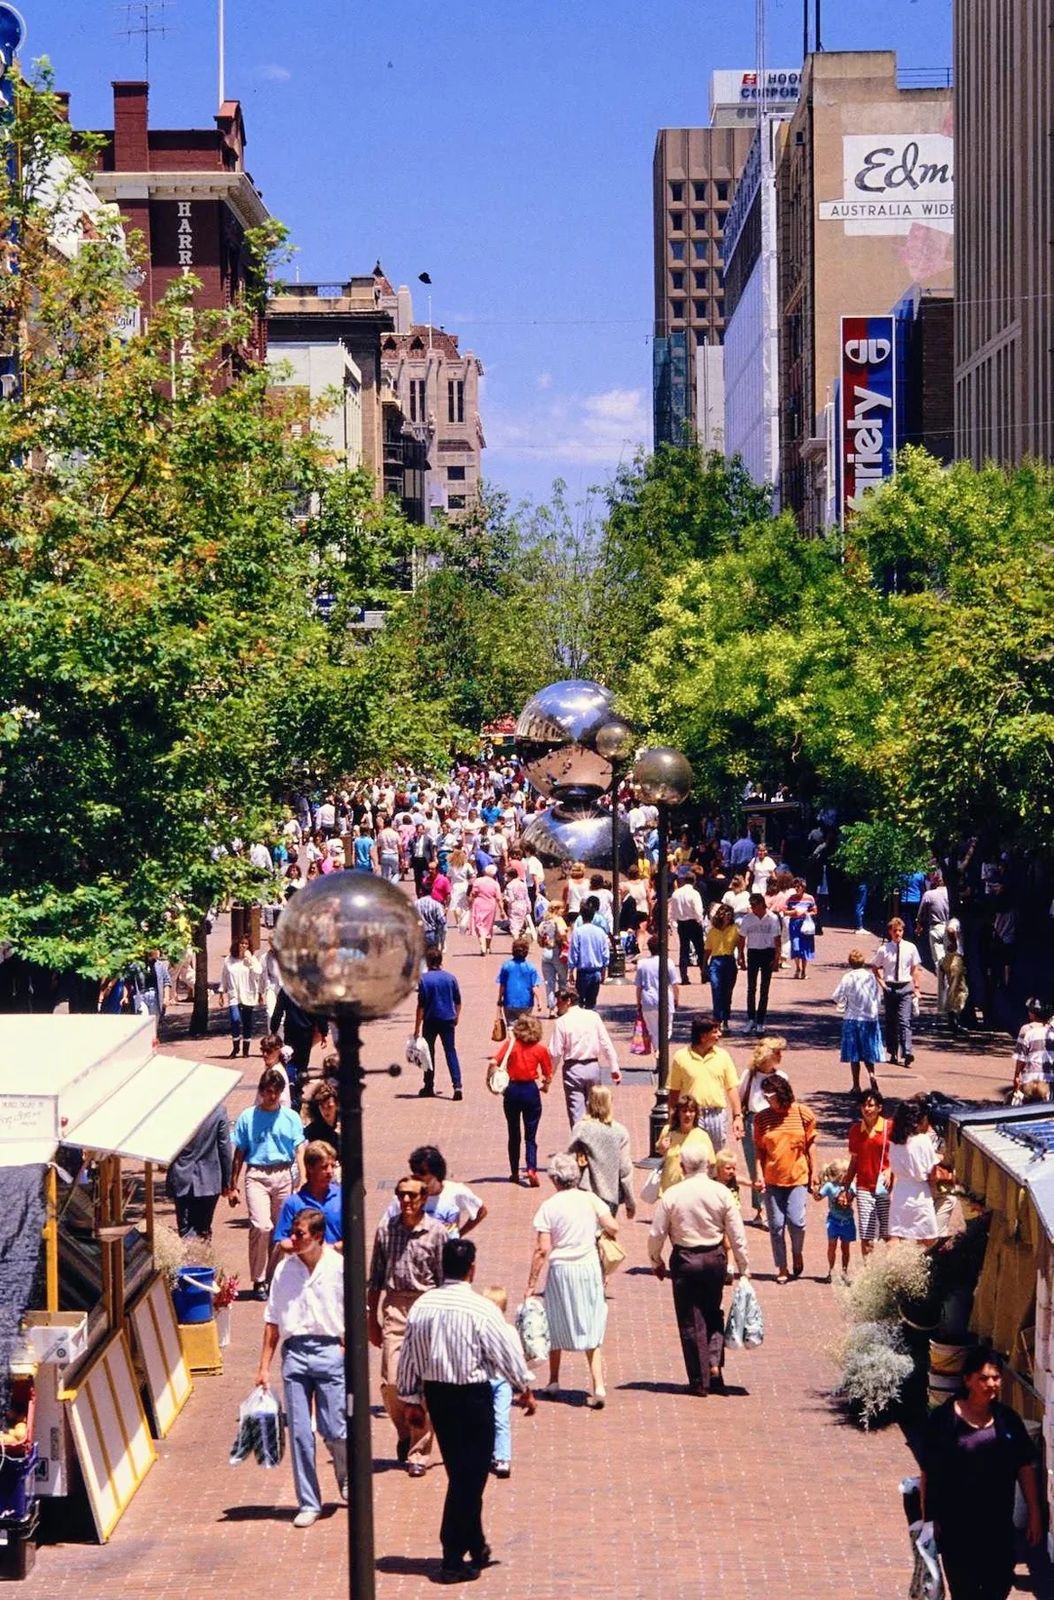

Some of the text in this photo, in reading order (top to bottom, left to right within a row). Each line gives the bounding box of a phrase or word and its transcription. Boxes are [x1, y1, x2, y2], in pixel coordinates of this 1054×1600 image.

[767, 73, 802, 84] HOO
[854, 141, 954, 193] Edm
[830, 203, 912, 217] AUSTRALIA
